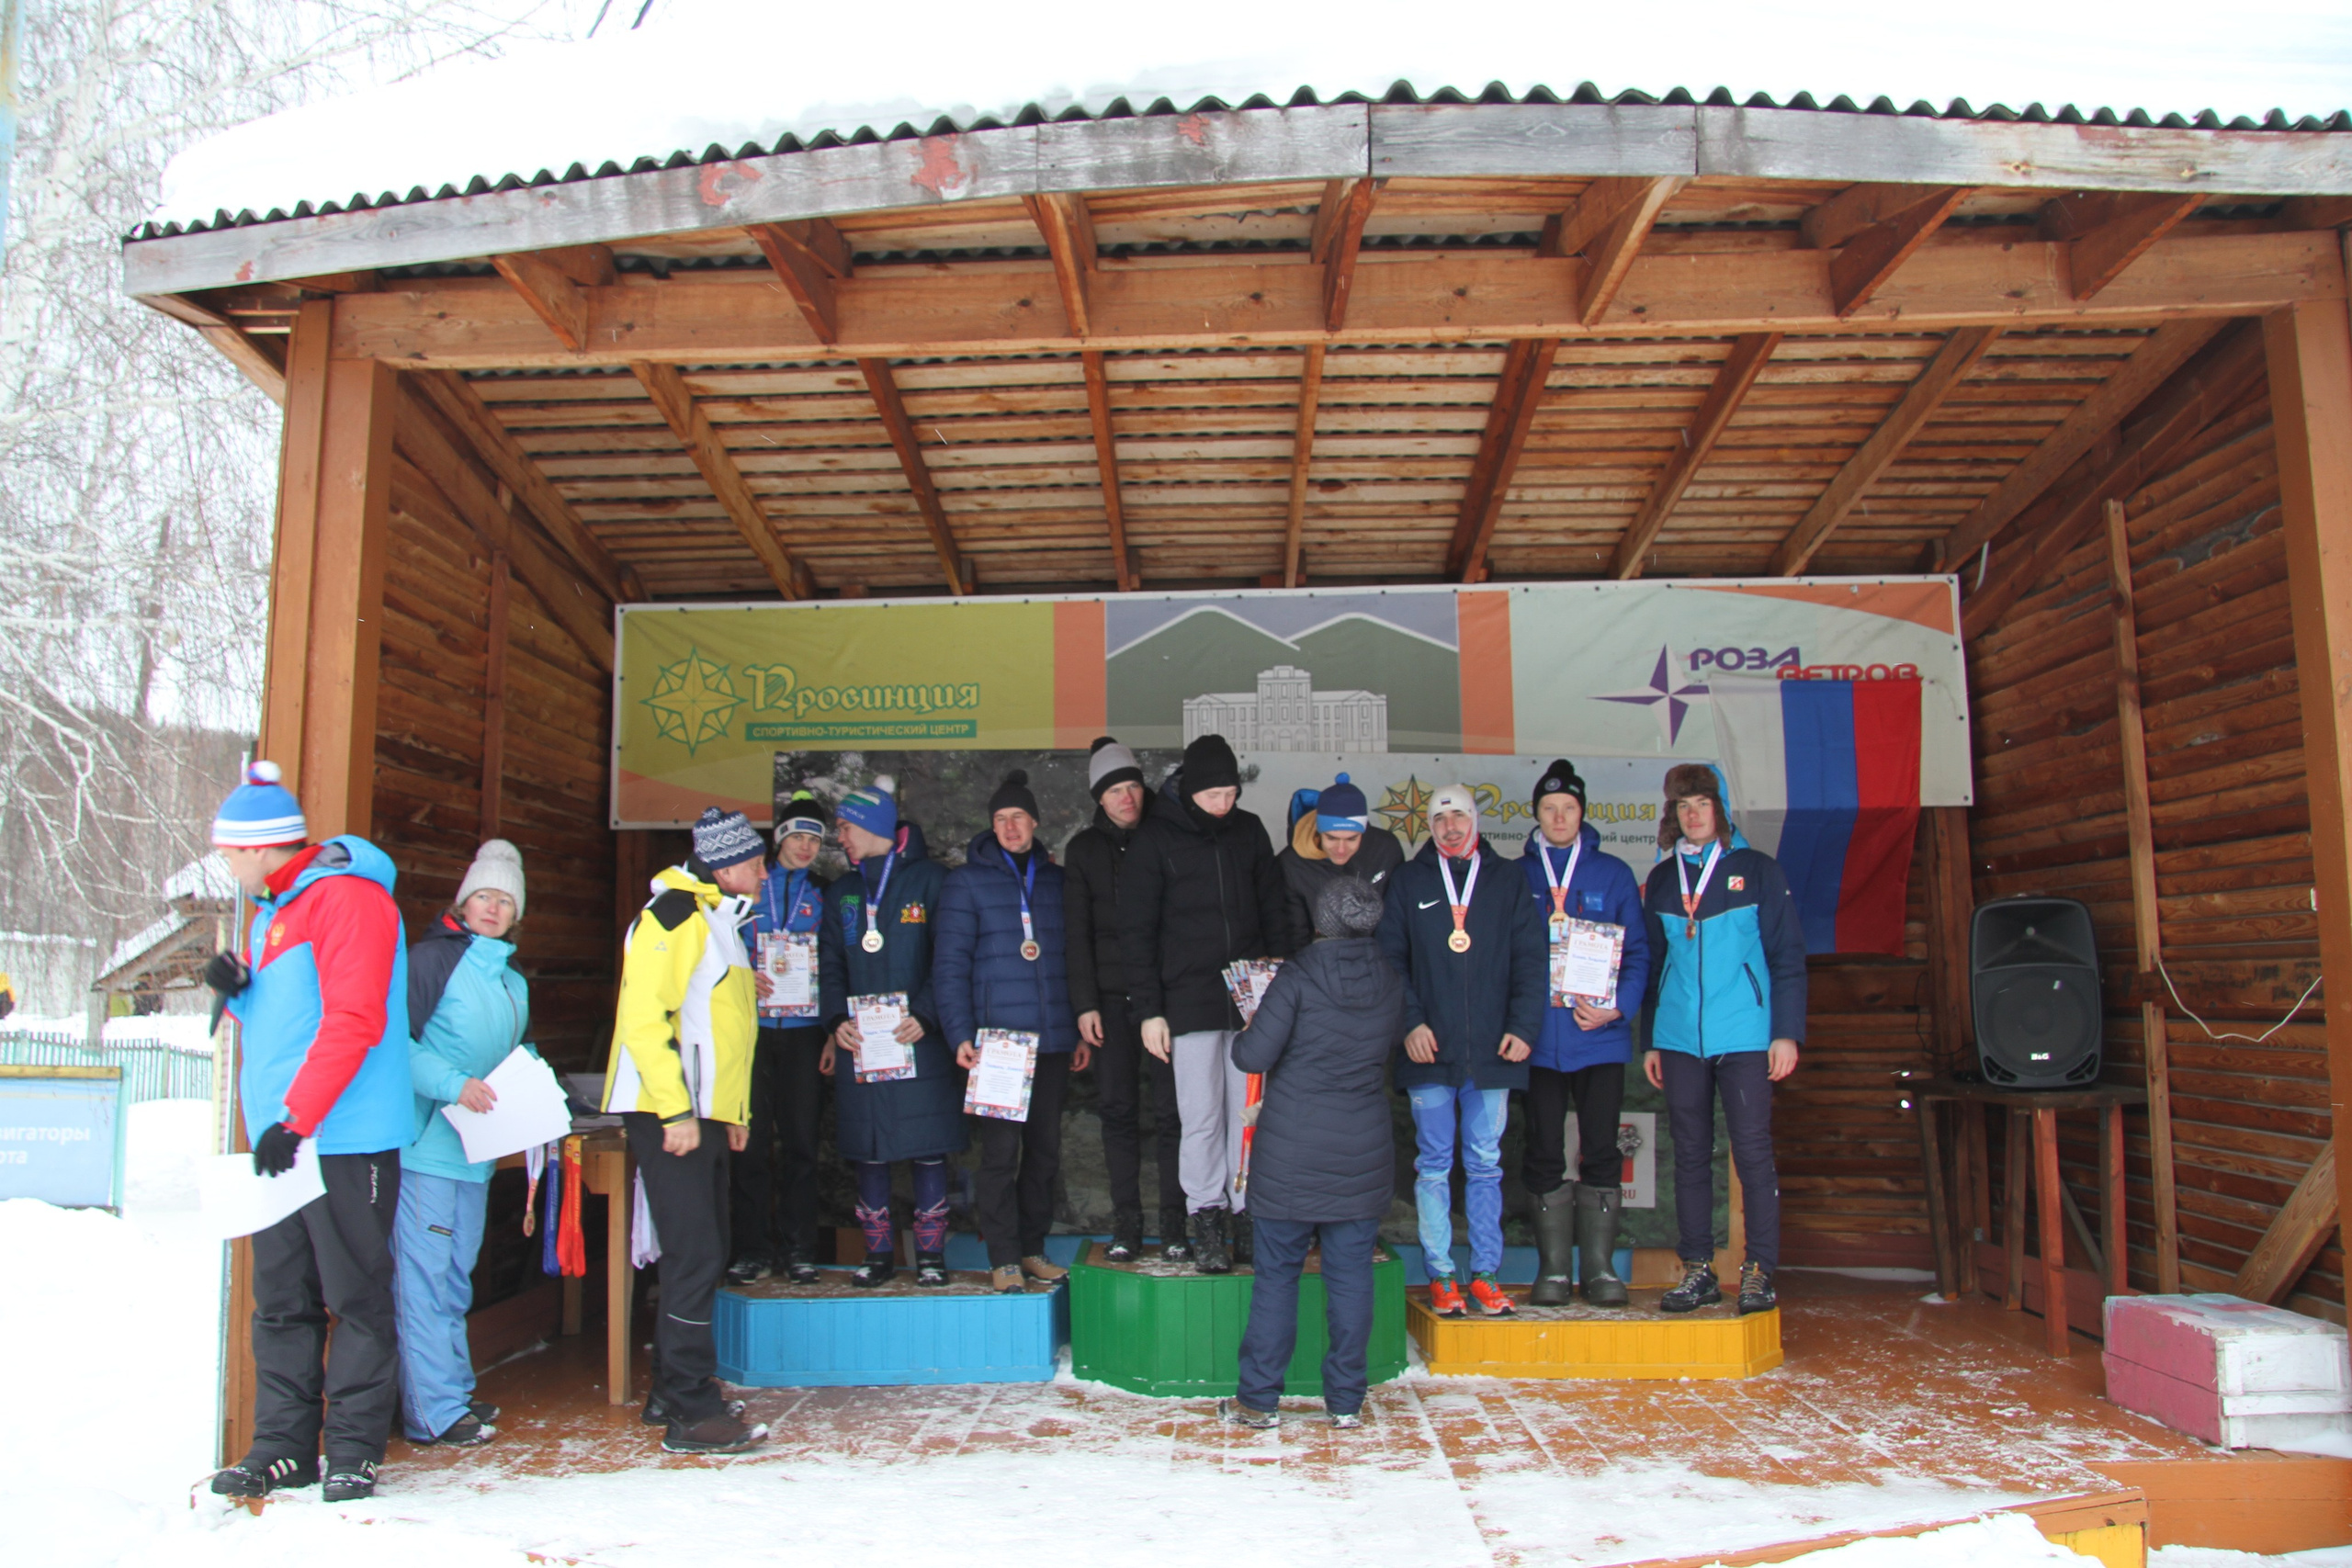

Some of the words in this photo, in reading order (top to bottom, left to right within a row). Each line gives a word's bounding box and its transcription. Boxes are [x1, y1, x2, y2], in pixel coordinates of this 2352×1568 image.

[1690, 647, 1801, 671] РОЗА
[742, 663, 980, 720] Провинция
[752, 724, 926, 737] СПОРТИВНО-ТУРИСТИЧЕСКИЙ
[930, 724, 969, 735] ЦЕНТР
[1620, 834, 1657, 845] центр
[0, 1127, 91, 1145] игаторы
